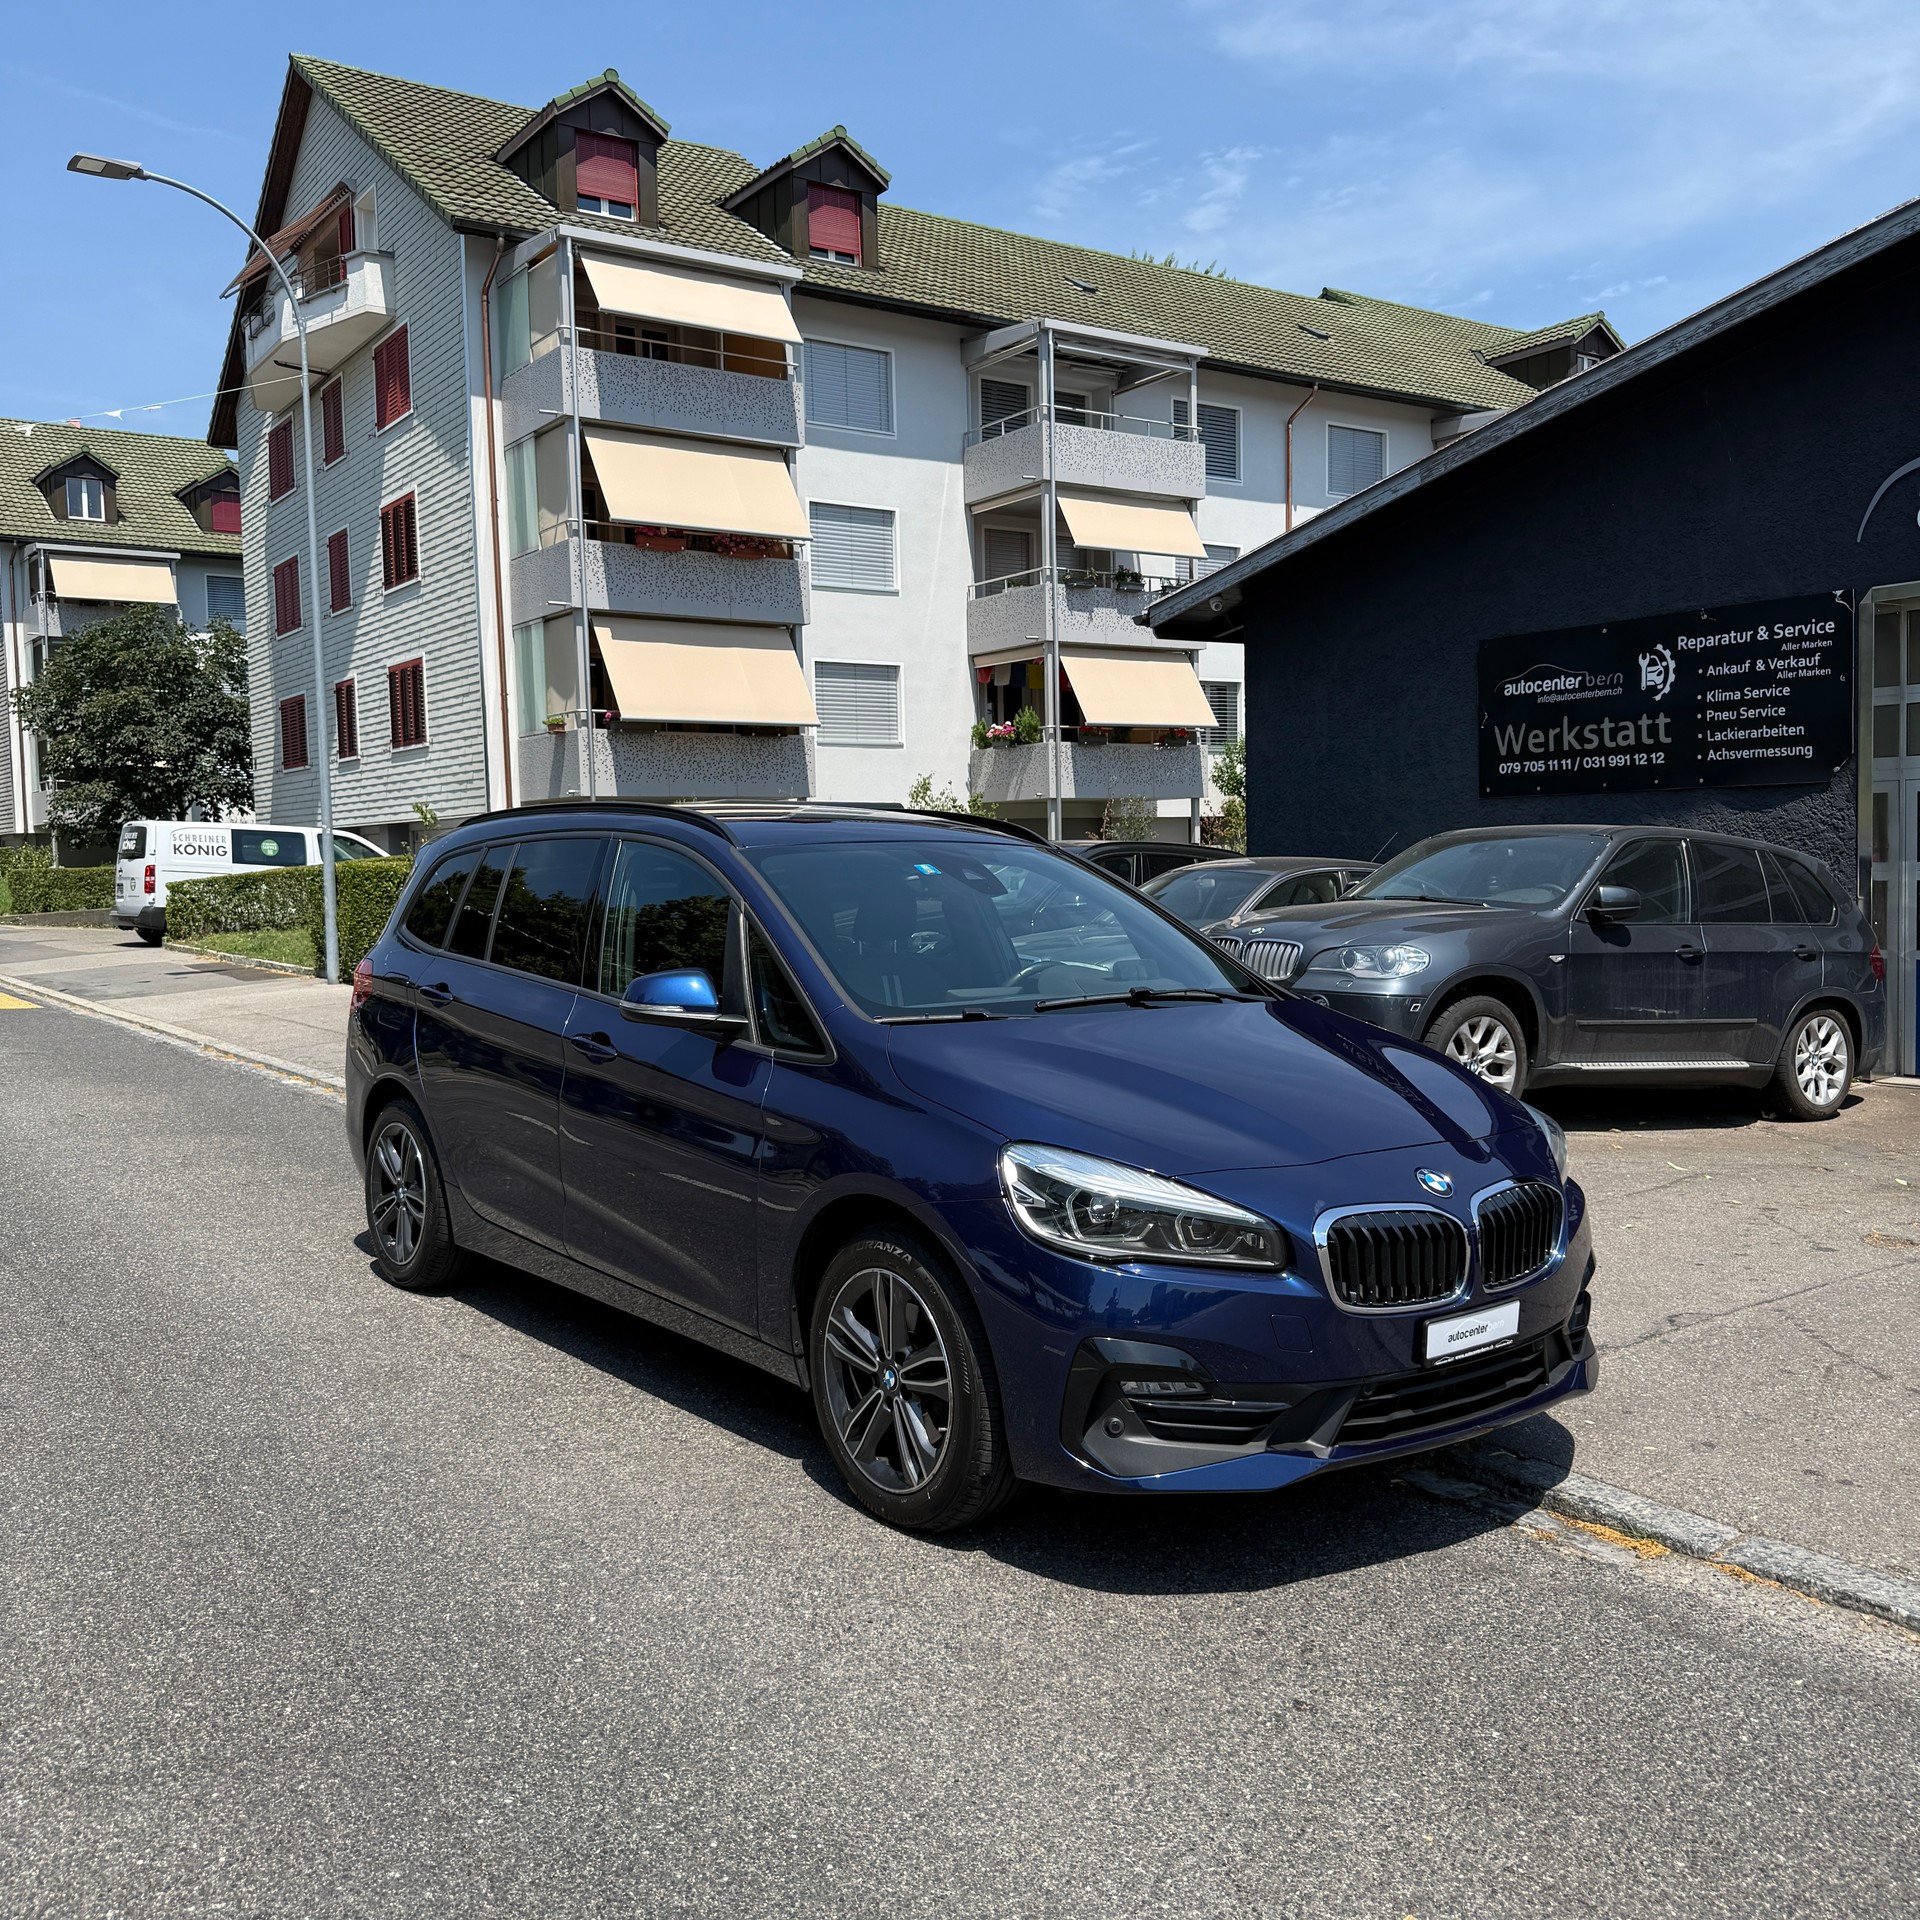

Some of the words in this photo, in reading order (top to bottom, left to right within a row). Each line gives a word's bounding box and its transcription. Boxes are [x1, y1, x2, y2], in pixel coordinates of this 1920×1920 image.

[1677, 630, 1753, 652] Reparatur
[1757, 625, 1769, 641] &
[1773, 619, 1835, 639] Service
[1781, 642, 1800, 651] Aller
[1801, 639, 1833, 649] Marken
[1706, 660, 1751, 676] Ankauf
[1755, 659, 1766, 671] &
[1768, 653, 1821, 670] Verkauf
[1776, 670, 1796, 679] Aller
[1798, 667, 1831, 678] Marken
[1537, 686, 1623, 703] info@autocenterbern.ch
[1706, 689, 1741, 703] Klima
[1743, 684, 1791, 699] Service
[1706, 710, 1737, 722] Pneu
[1740, 704, 1786, 719] Service
[1494, 712, 1672, 756] Werkstatt
[1707, 723, 1805, 742] Lackierarbeiten
[1707, 745, 1813, 761] Achsvermessung
[1499, 761, 1521, 774] 079
[1523, 760, 1545, 773] 705
[1549, 759, 1559, 771] 11
[1561, 758, 1572, 770] 11
[1583, 756, 1606, 769] 031
[1608, 754, 1631, 767] 991
[1633, 753, 1648, 766] 12
[1650, 752, 1665, 765] 12
[172, 833, 227, 844] SCHREINER
[173, 842, 228, 857] KÖNIG
